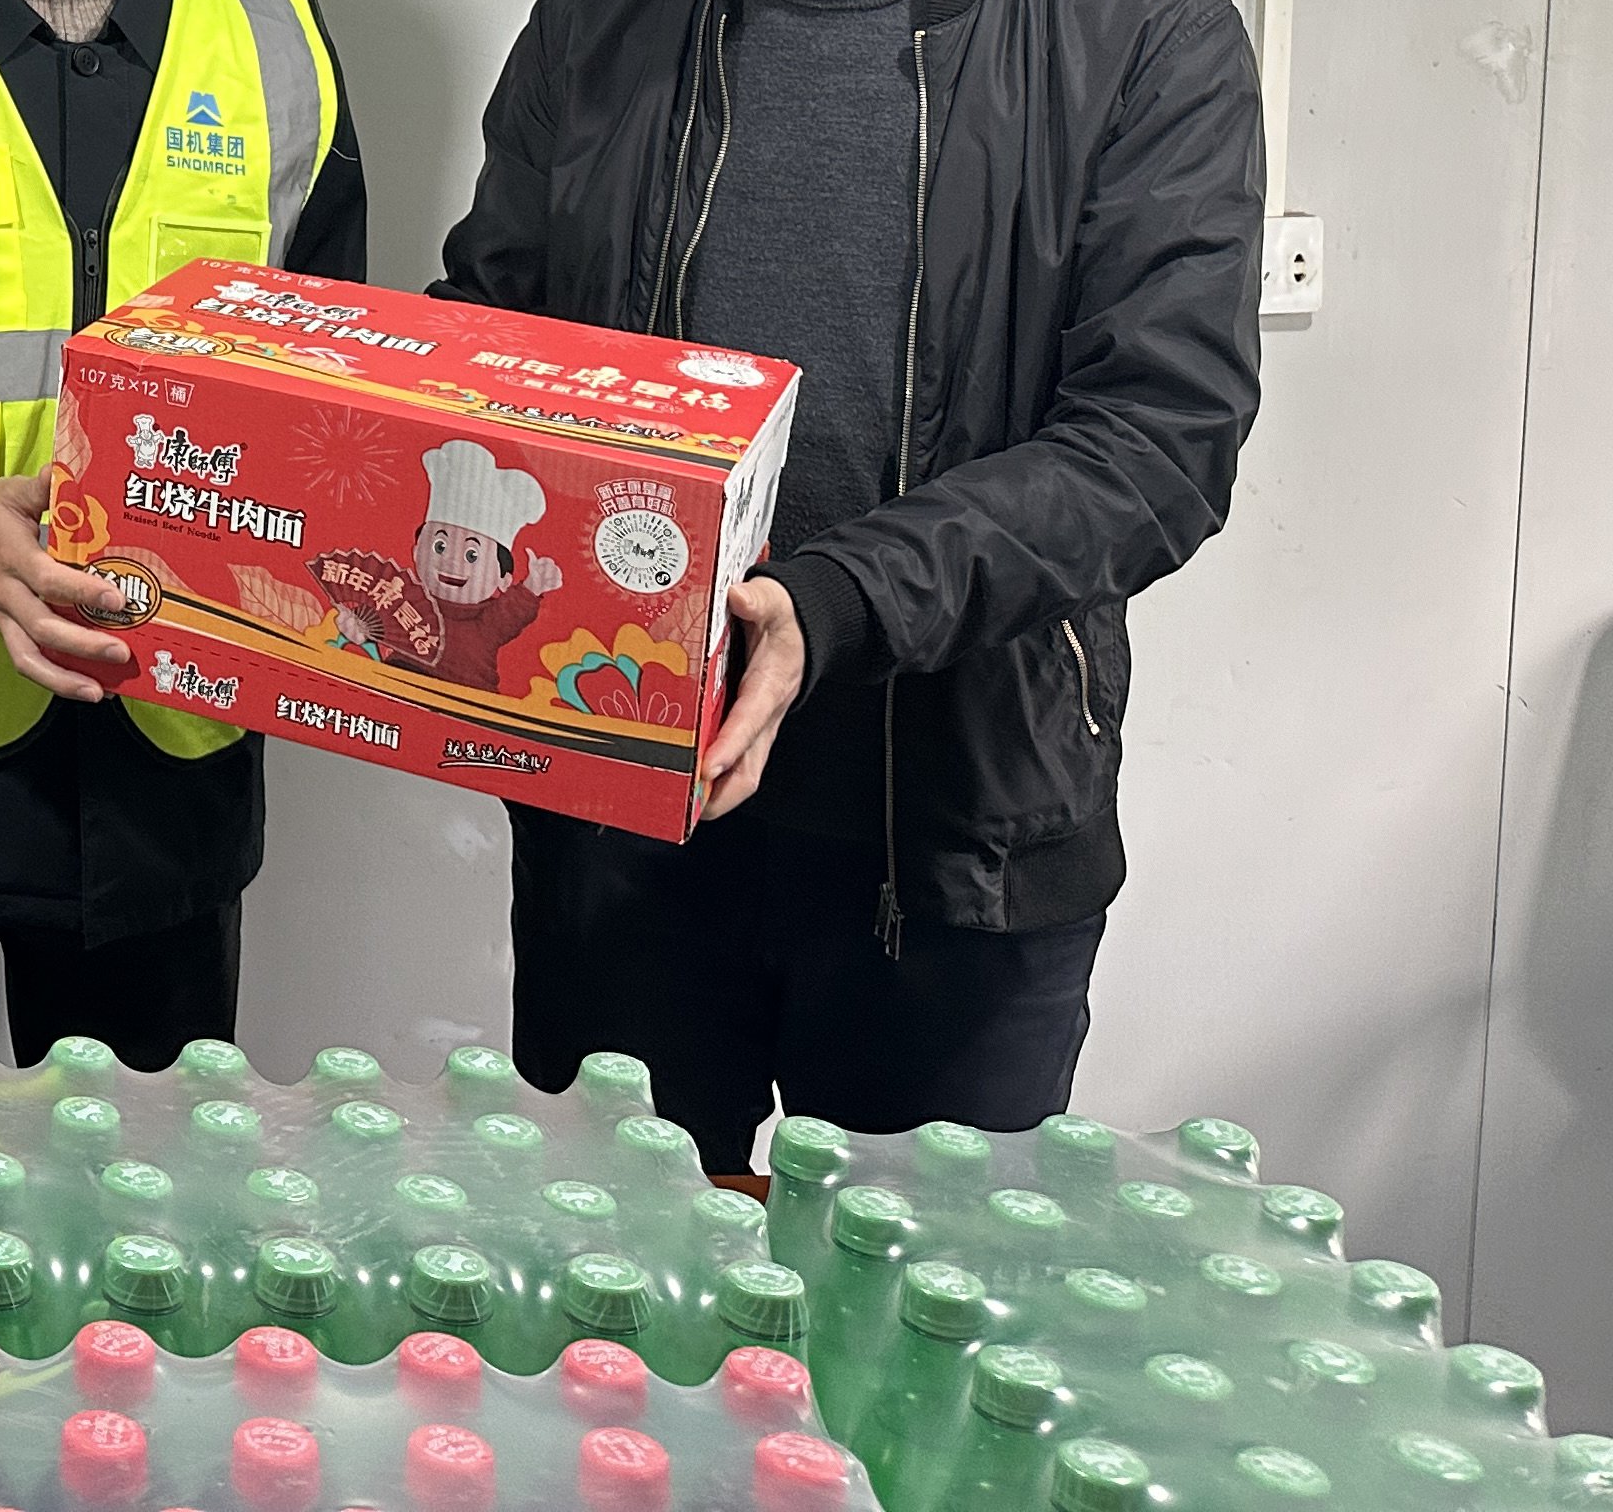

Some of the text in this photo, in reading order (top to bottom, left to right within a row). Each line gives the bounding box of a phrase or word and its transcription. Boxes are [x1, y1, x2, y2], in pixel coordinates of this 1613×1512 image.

[166, 126, 244, 160] 国机集团
[166, 155, 246, 176] SINOMACH
[192, 297, 441, 356] 红烧牛肉面
[469, 351, 732, 411] 新年康是福
[124, 472, 305, 548] 红烧牛肉面
[162, 521, 184, 534] Beef
[87, 565, 151, 614] 典
[275, 694, 402, 751] 红烧牛肉面
